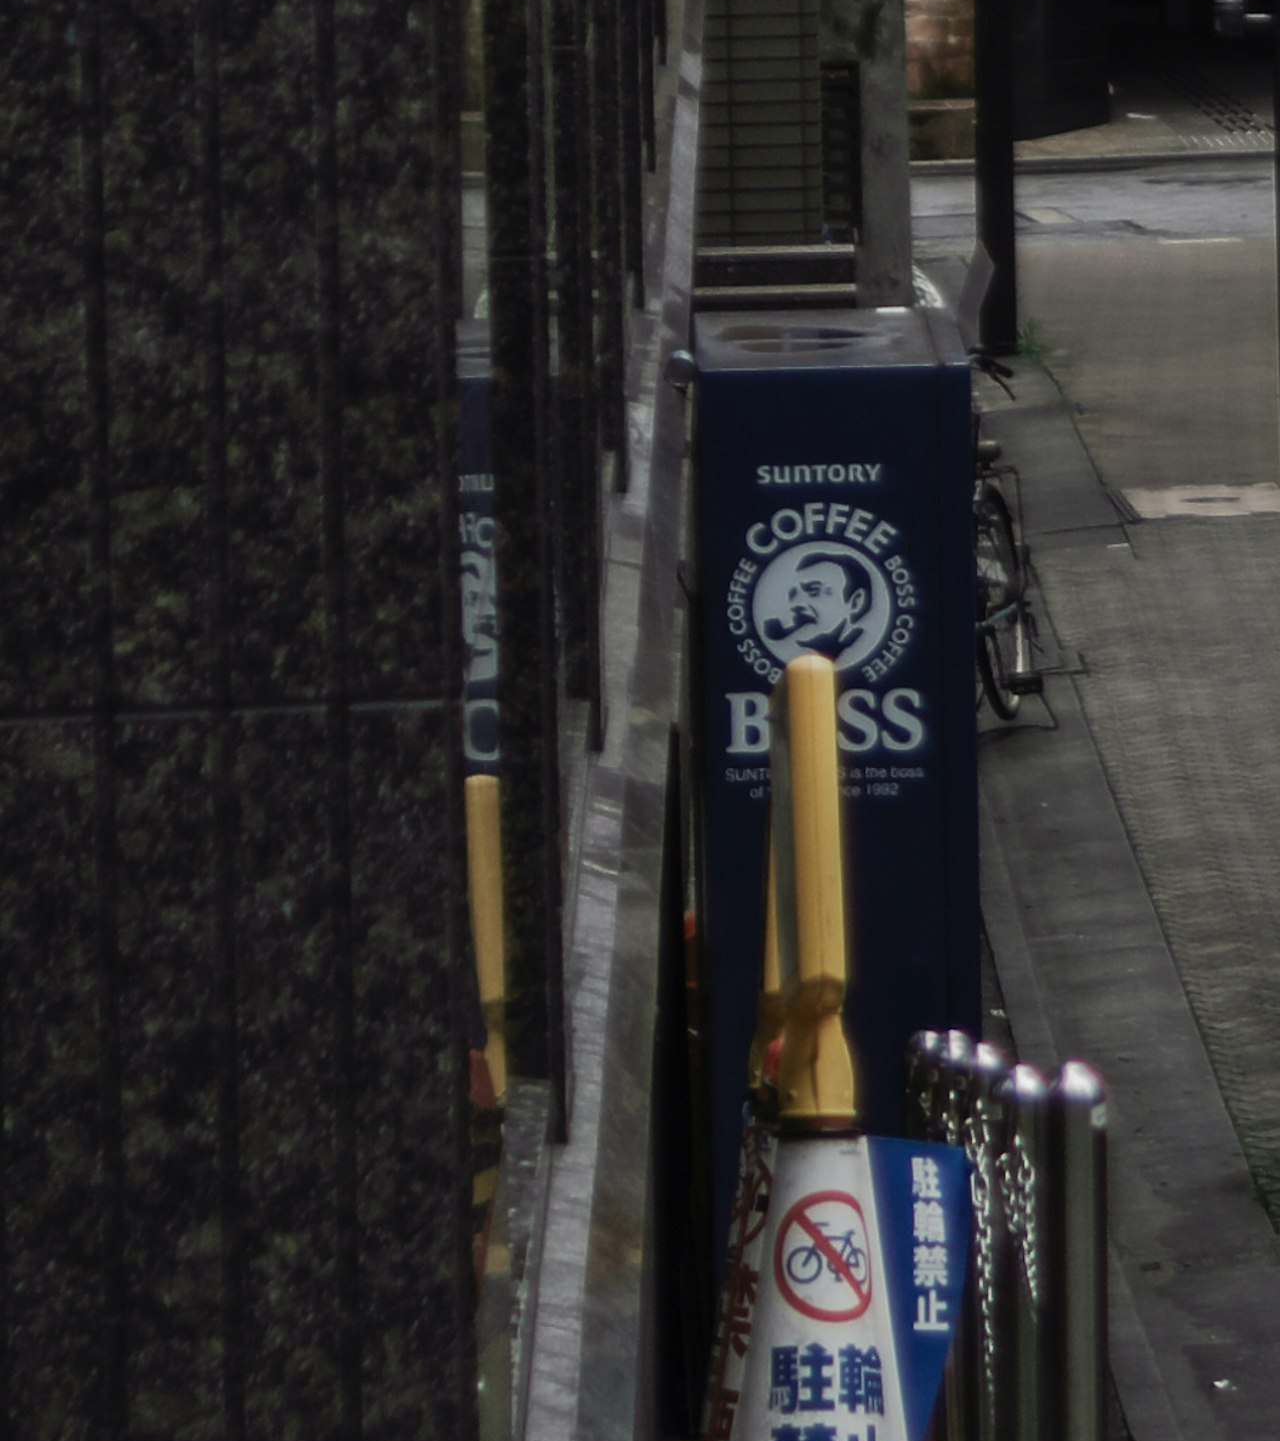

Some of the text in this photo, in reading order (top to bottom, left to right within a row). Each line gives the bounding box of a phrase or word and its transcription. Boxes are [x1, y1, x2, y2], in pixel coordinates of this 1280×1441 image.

[756, 462, 882, 485] SUNTORY
[745, 502, 898, 554] COFFEE
[727, 557, 785, 685] BOSS COFFEE
[861, 554, 916, 683] BOSS COFFEE
[725, 687, 924, 754] BSS
[911, 1157, 951, 1332] 駐輪禁止
[769, 1342, 885, 1417] 駐輪
